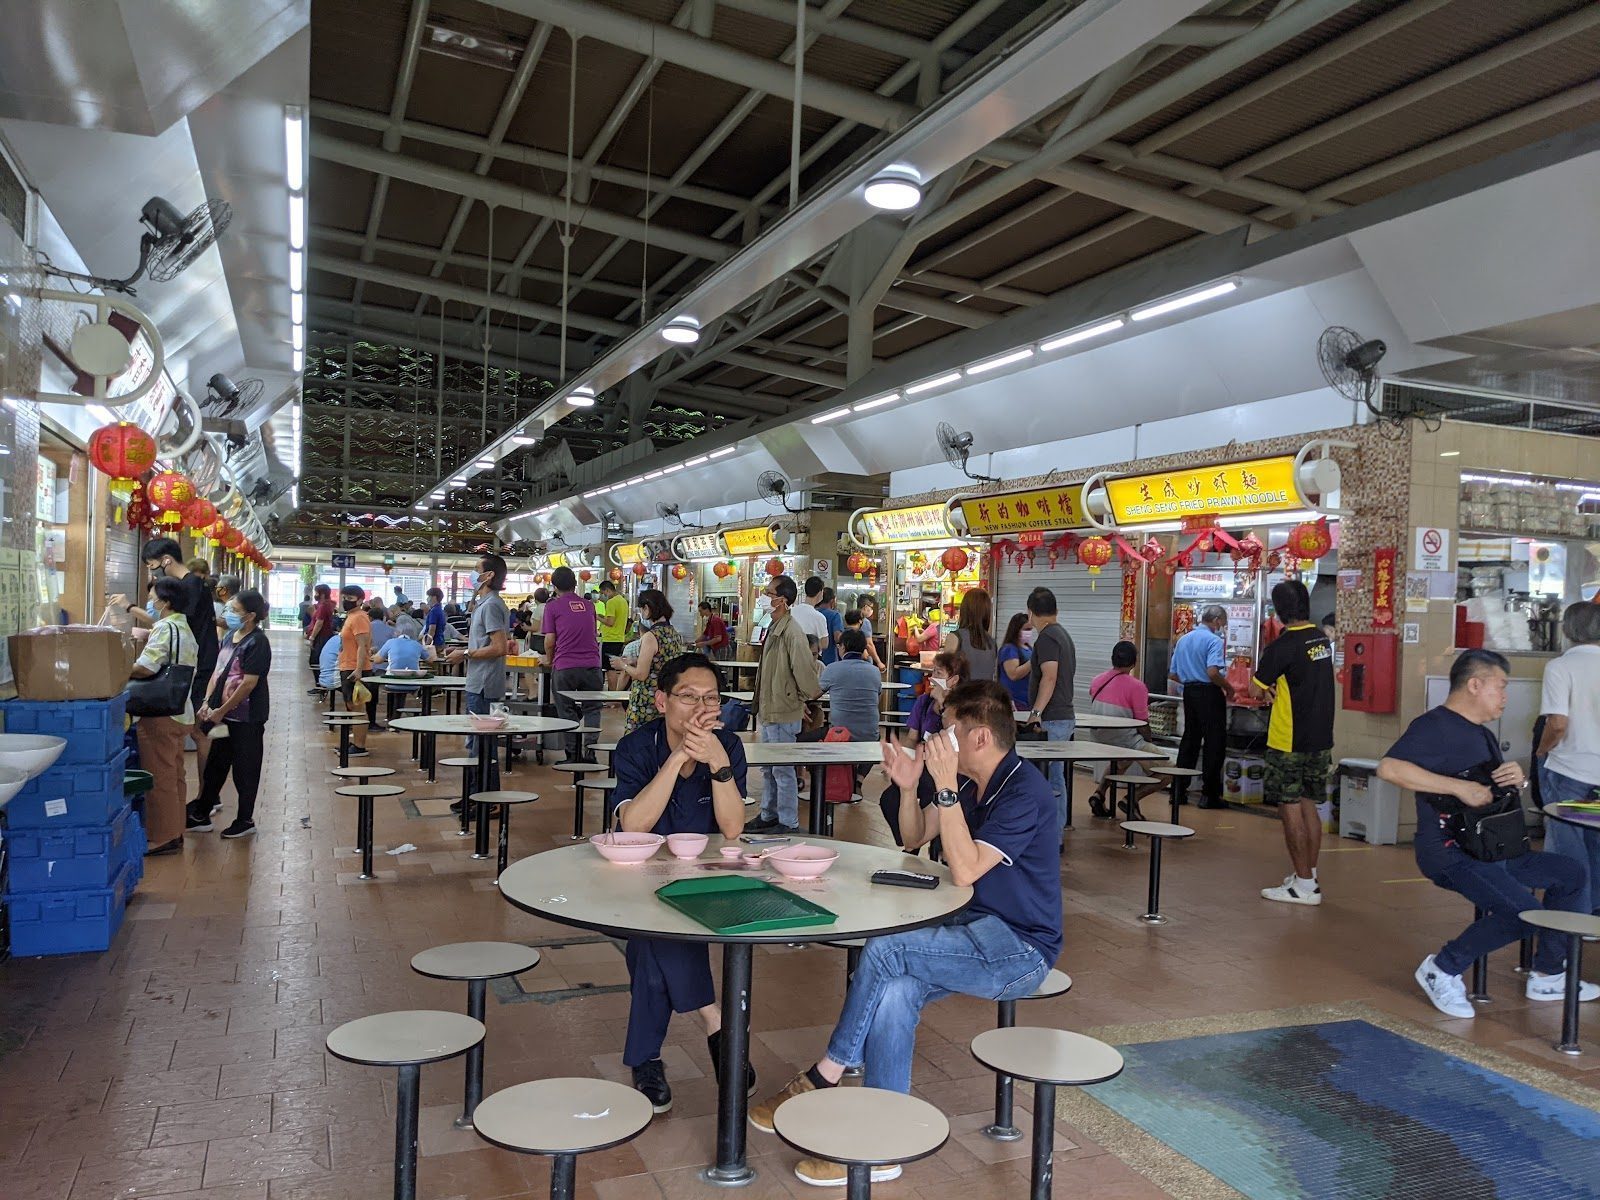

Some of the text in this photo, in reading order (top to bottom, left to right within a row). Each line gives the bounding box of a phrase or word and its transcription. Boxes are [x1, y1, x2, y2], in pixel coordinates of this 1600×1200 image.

[1125, 490, 1288, 516] SHENG SENG FRIED PRAWN NOODLE
[985, 523, 999, 532] NEW
[1001, 521, 1028, 530] FASHION
[1028, 519, 1053, 529] COFFEE
[1054, 517, 1076, 526] STALL
